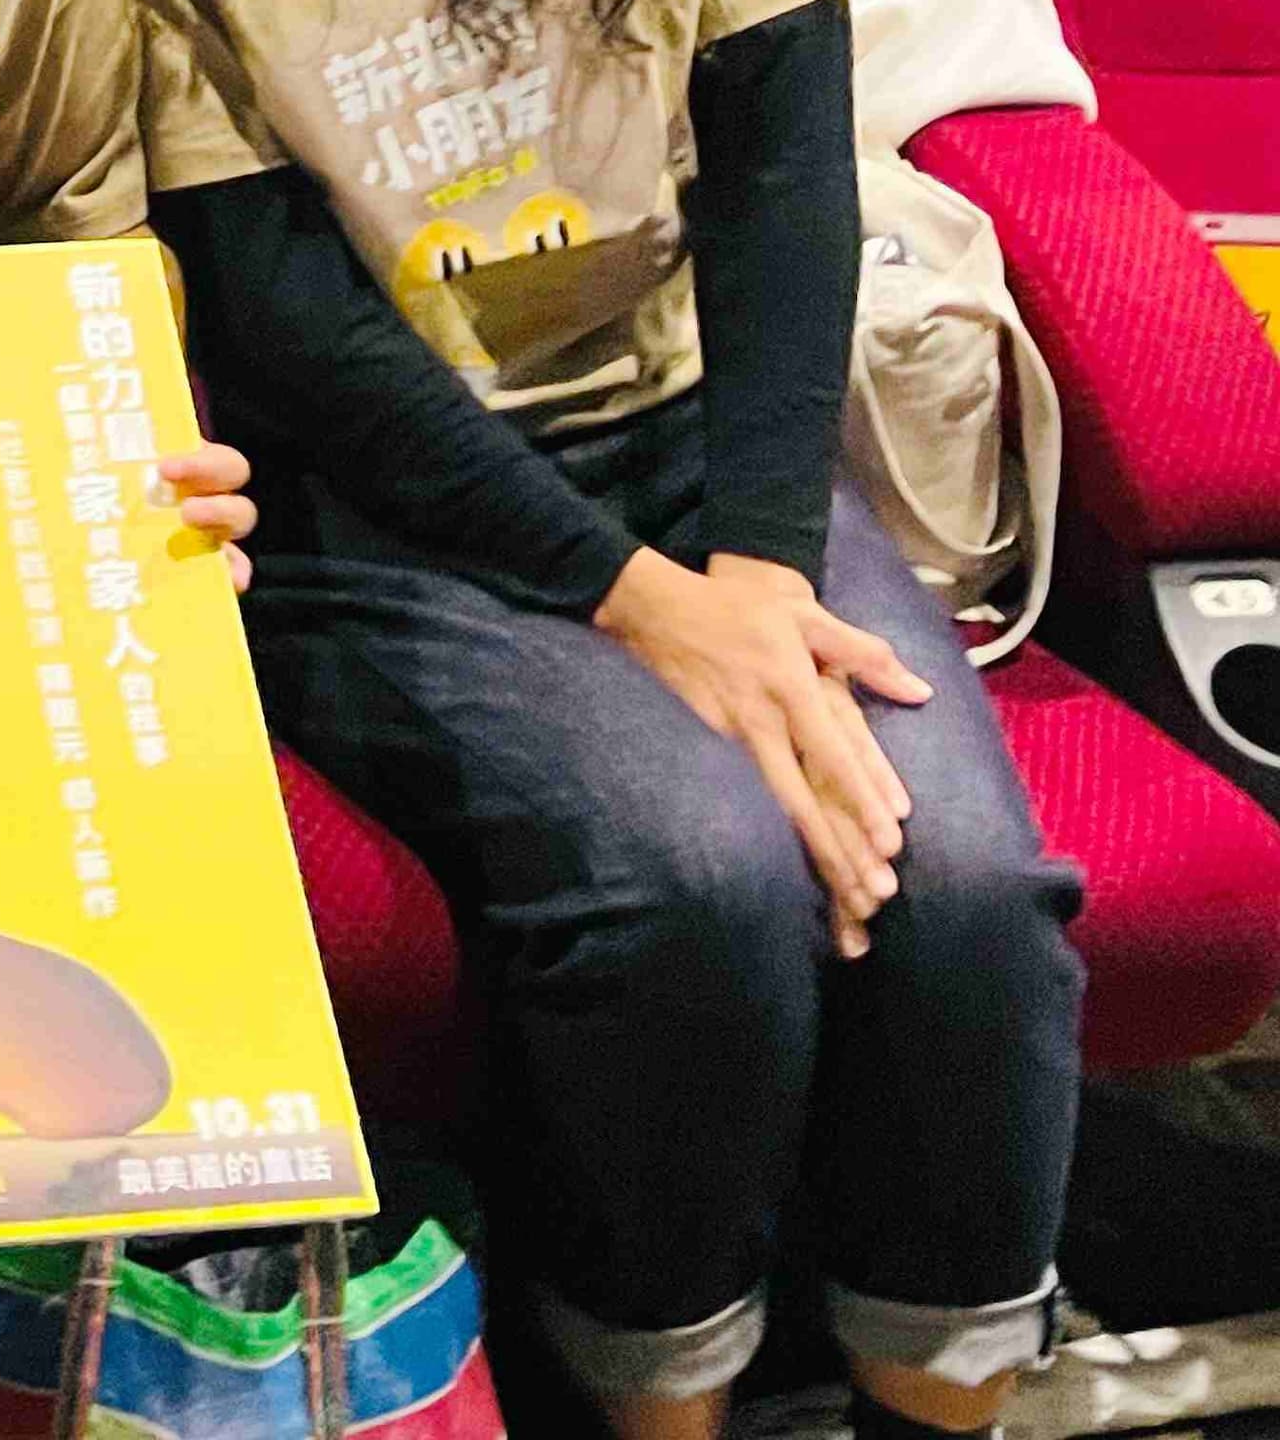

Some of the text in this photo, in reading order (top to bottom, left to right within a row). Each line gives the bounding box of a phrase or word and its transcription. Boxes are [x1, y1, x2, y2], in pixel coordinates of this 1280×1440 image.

[360, 65, 557, 192] 小朋友
[189, 1091, 320, 1141] 10.31
